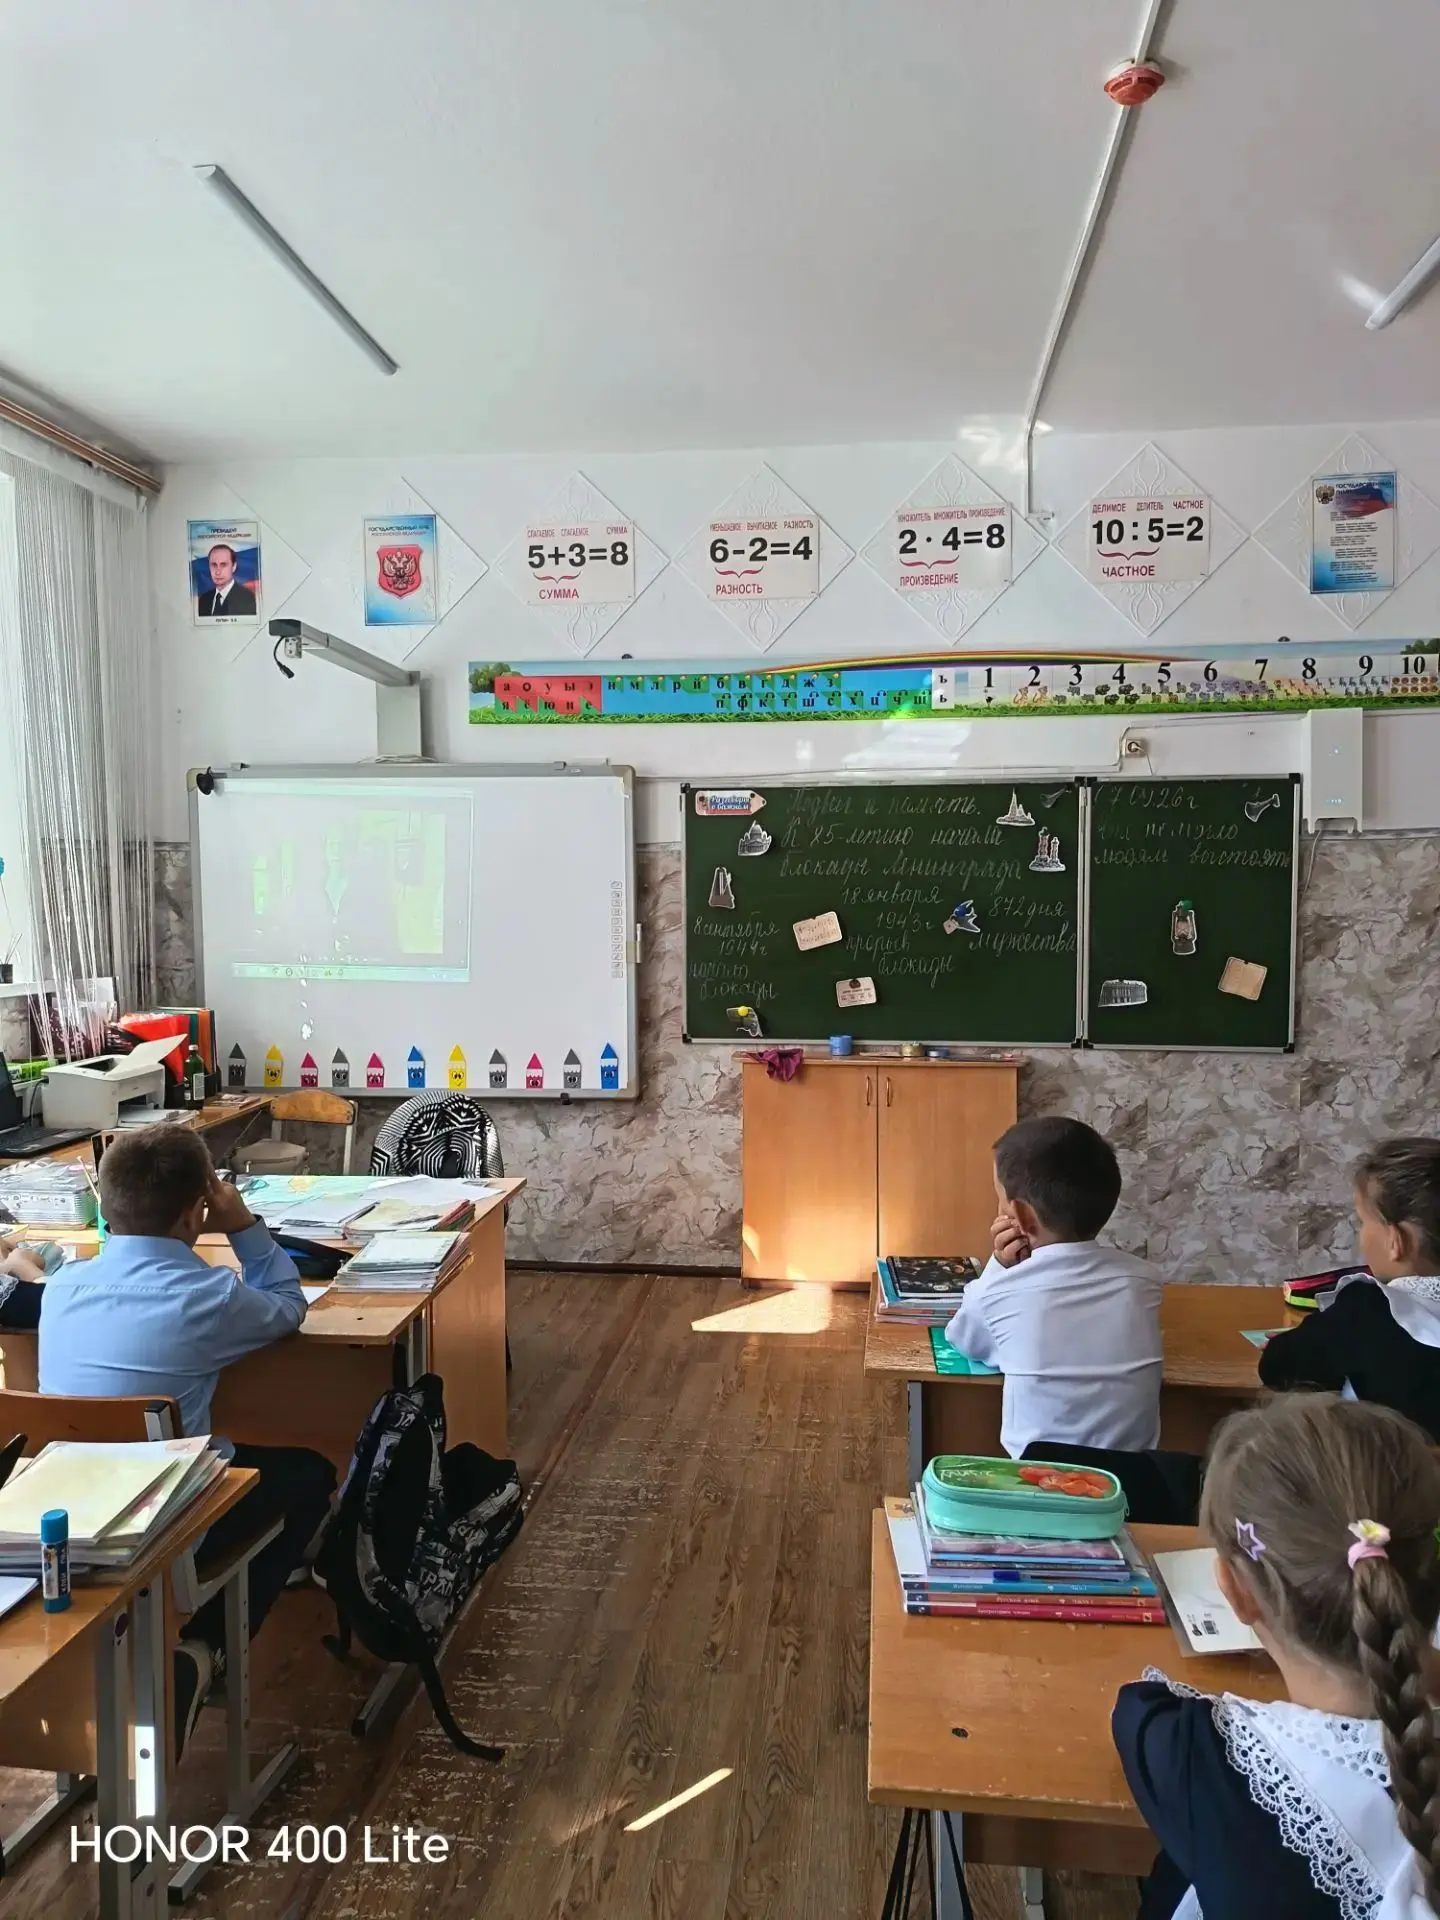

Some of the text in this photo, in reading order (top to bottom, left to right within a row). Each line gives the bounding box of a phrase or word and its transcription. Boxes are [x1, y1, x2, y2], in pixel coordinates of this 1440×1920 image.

[1092, 503, 1126, 513] ДЕЛИМОЕ
[1172, 500, 1204, 510] ЧАСТНОЕ
[606, 526, 628, 535] СУММА
[783, 520, 814, 529] РАЗНОСТЬ
[1102, 565, 1155, 577] ЧАСТНОЕ
[899, 573, 959, 586] ПРОИЗВЕДЕНИЕ
[539, 588, 579, 599] СУММА
[715, 583, 763, 595] РАЗНОСТЬ
[984, 655, 1426, 688] 1 2 3 4 5 6 7 8 9 10
